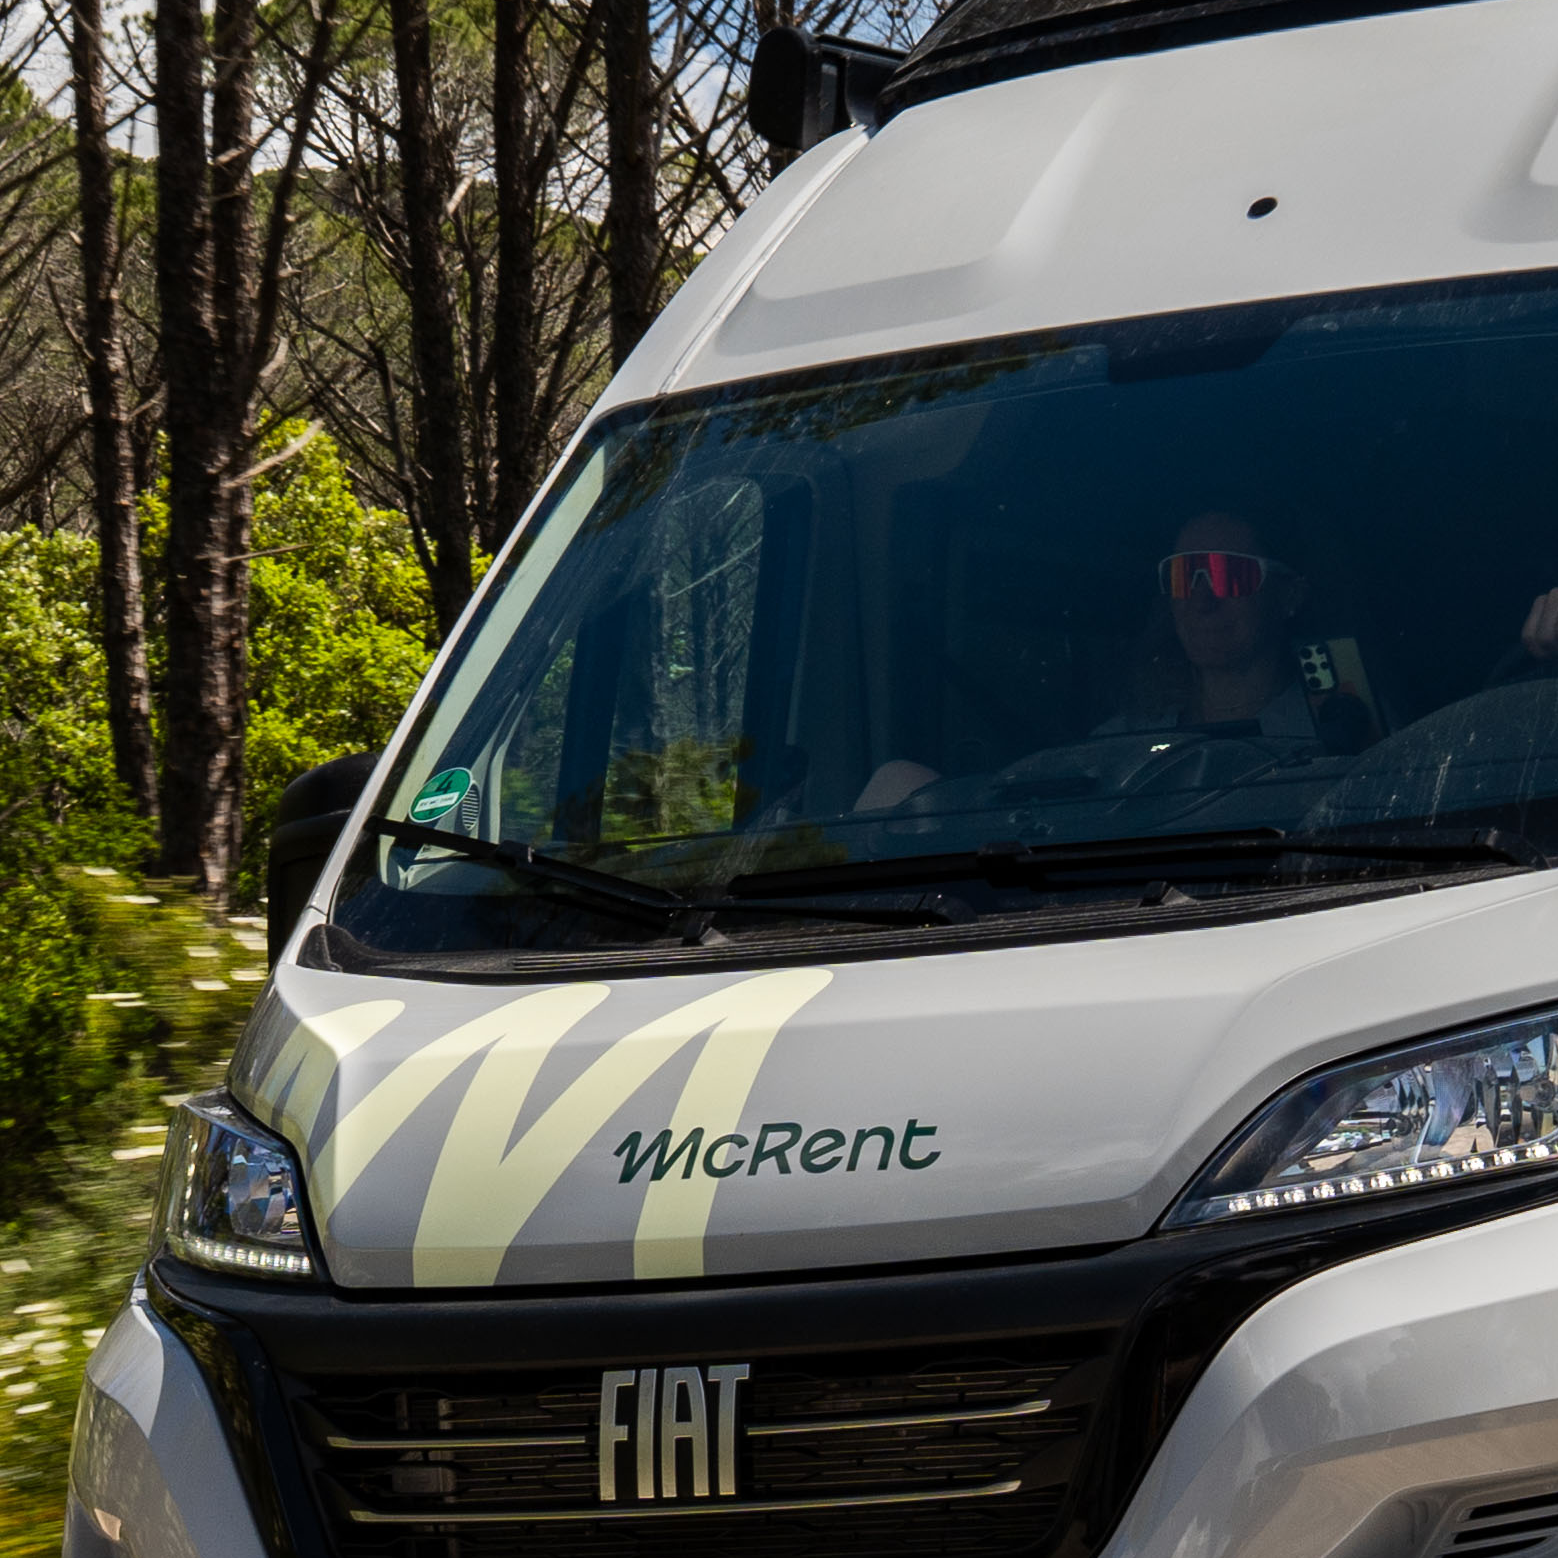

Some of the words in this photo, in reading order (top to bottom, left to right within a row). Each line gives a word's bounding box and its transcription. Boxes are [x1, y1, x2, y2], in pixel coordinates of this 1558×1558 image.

[435, 770, 453, 794] 4
[613, 1119, 941, 1183] McRent
[600, 1364, 750, 1501] FIAT
